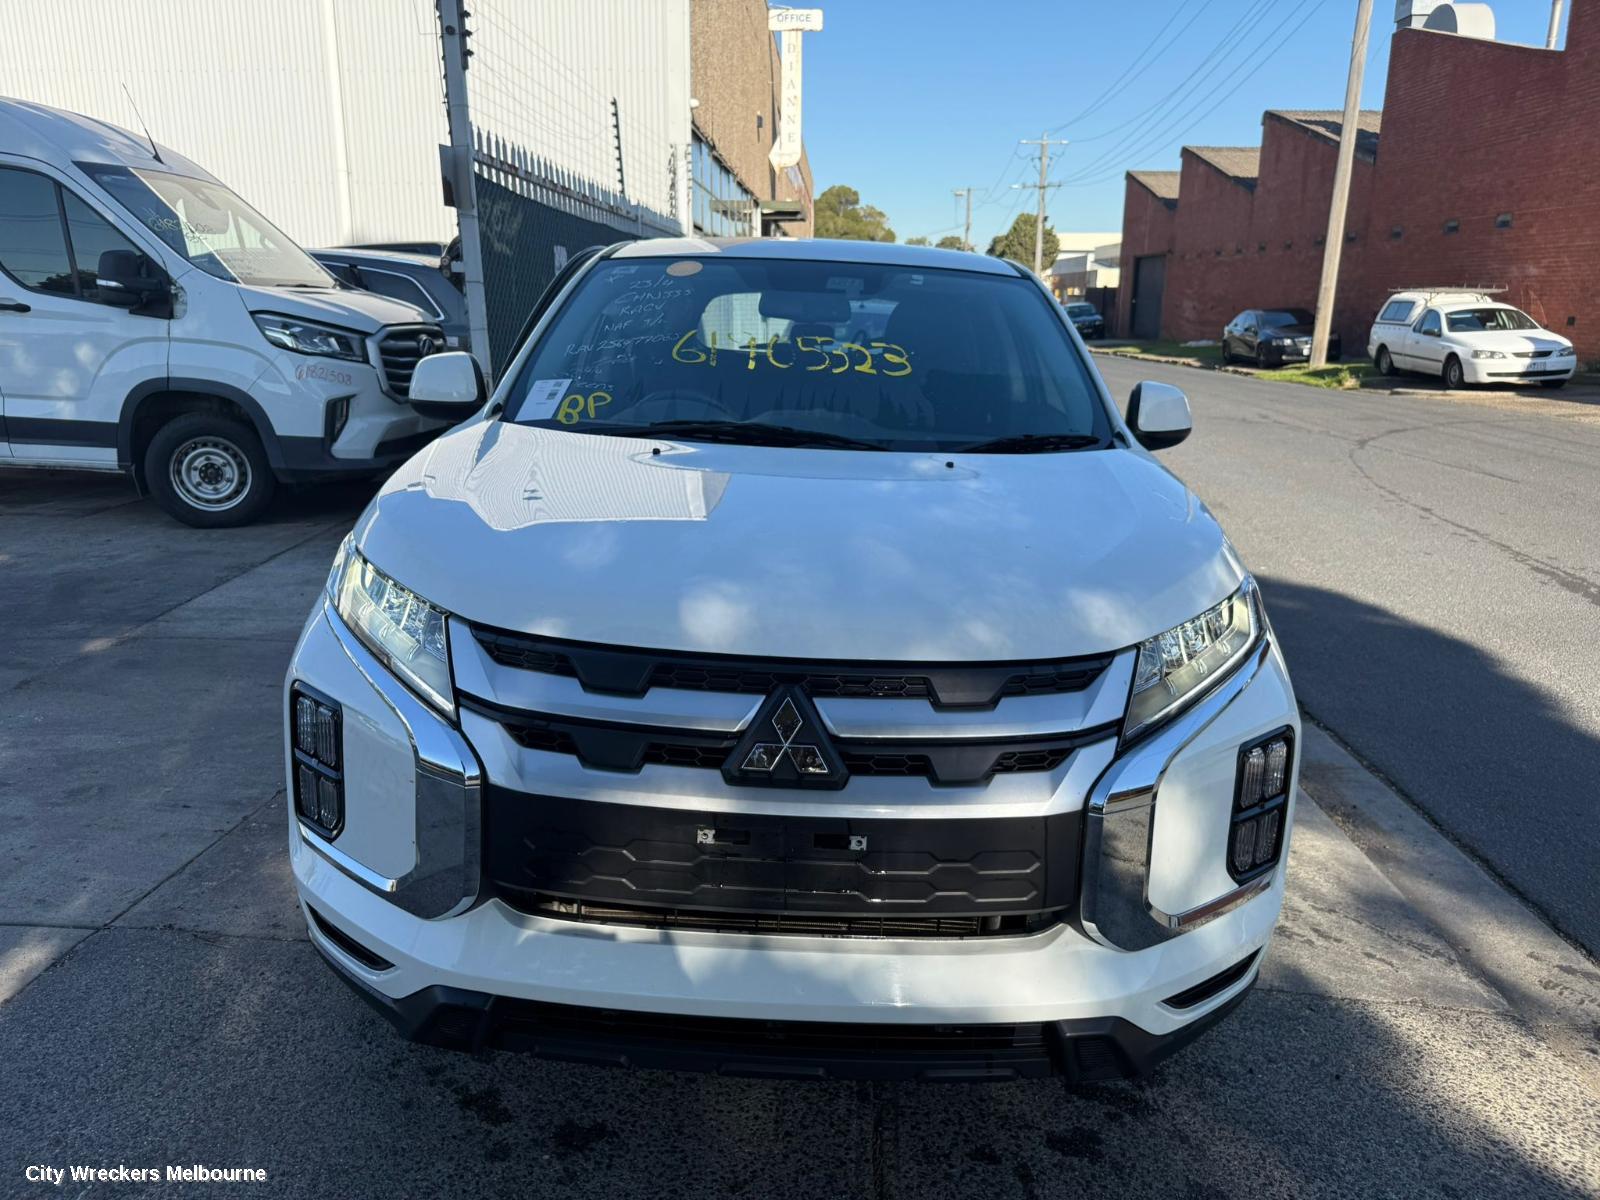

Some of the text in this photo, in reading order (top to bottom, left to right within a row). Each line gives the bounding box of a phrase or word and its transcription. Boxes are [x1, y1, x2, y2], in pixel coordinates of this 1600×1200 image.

[777, 13, 812, 23] OFFICE
[787, 43, 797, 143] DIANNE
[556, 391, 613, 424] BP
